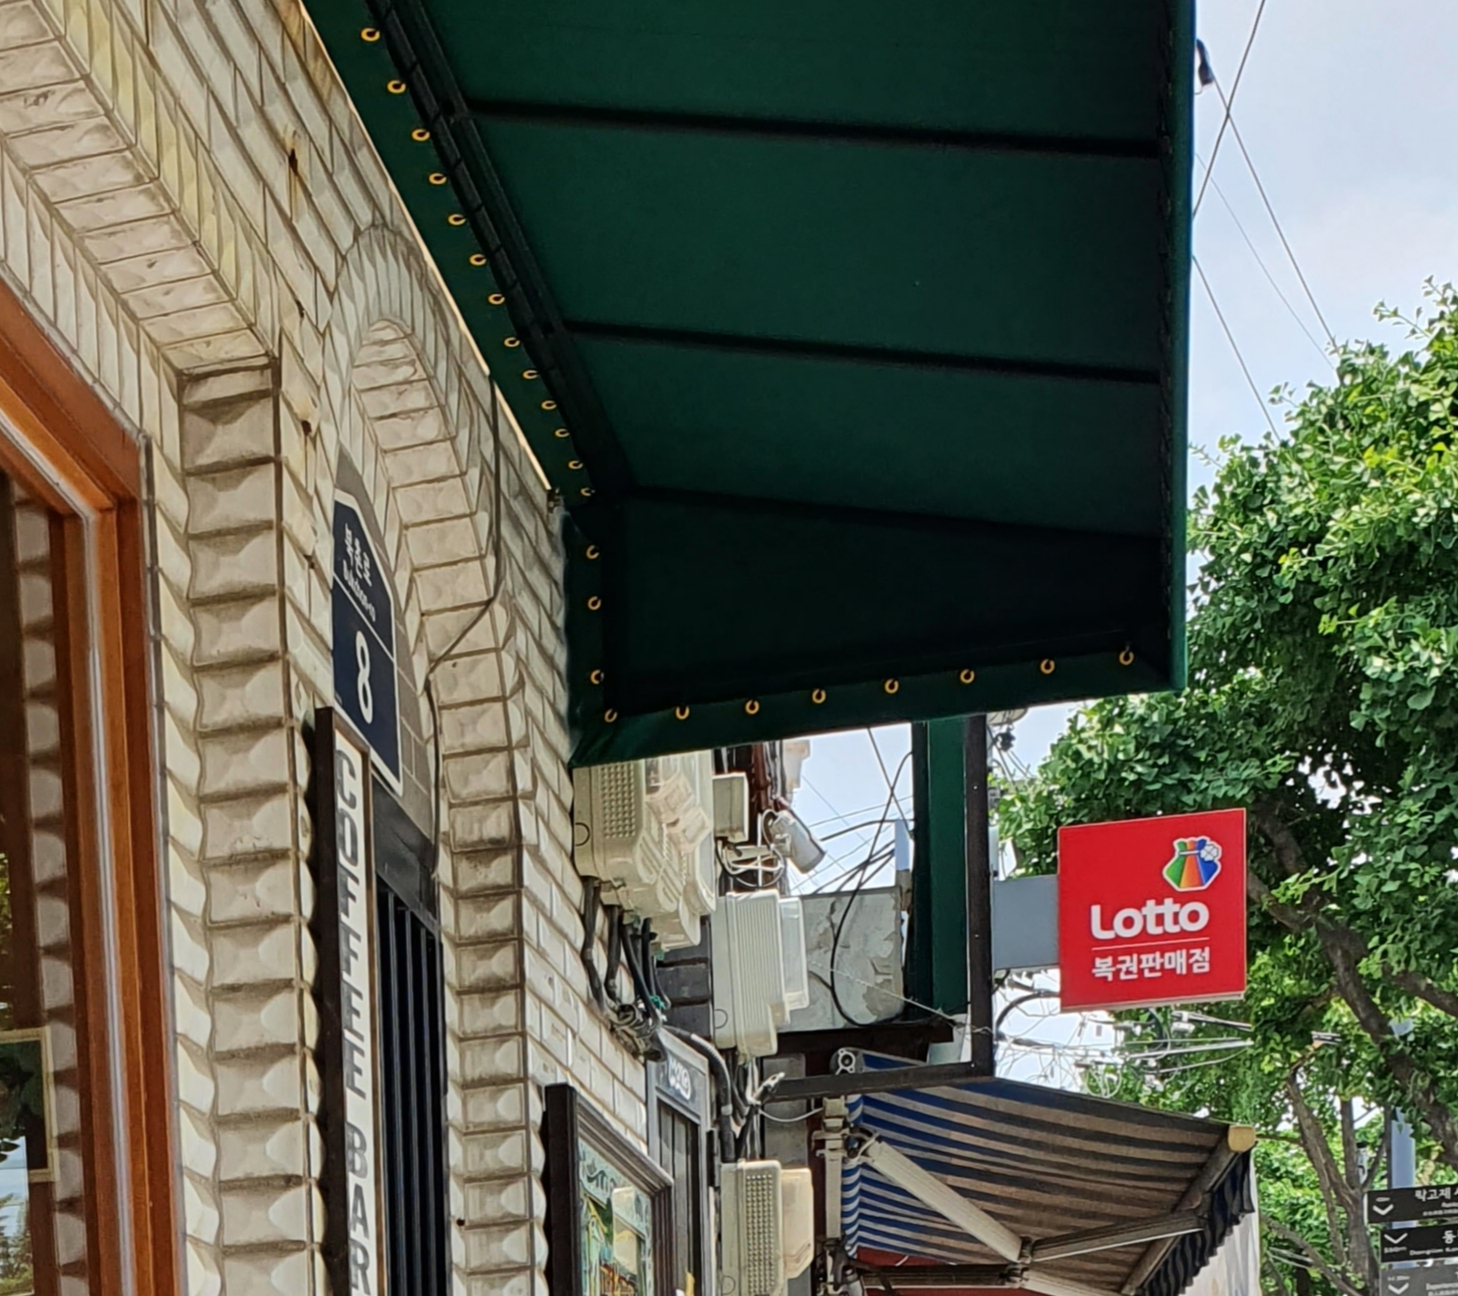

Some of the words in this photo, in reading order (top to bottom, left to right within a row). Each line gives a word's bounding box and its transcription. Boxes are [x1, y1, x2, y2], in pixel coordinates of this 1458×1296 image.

[355, 630, 373, 725] 8
[335, 749, 367, 1100] COFFEE
[1091, 897, 1210, 940] Lotto
[1092, 947, 1210, 982] 복권판매점
[345, 1121, 372, 1296] BAR
